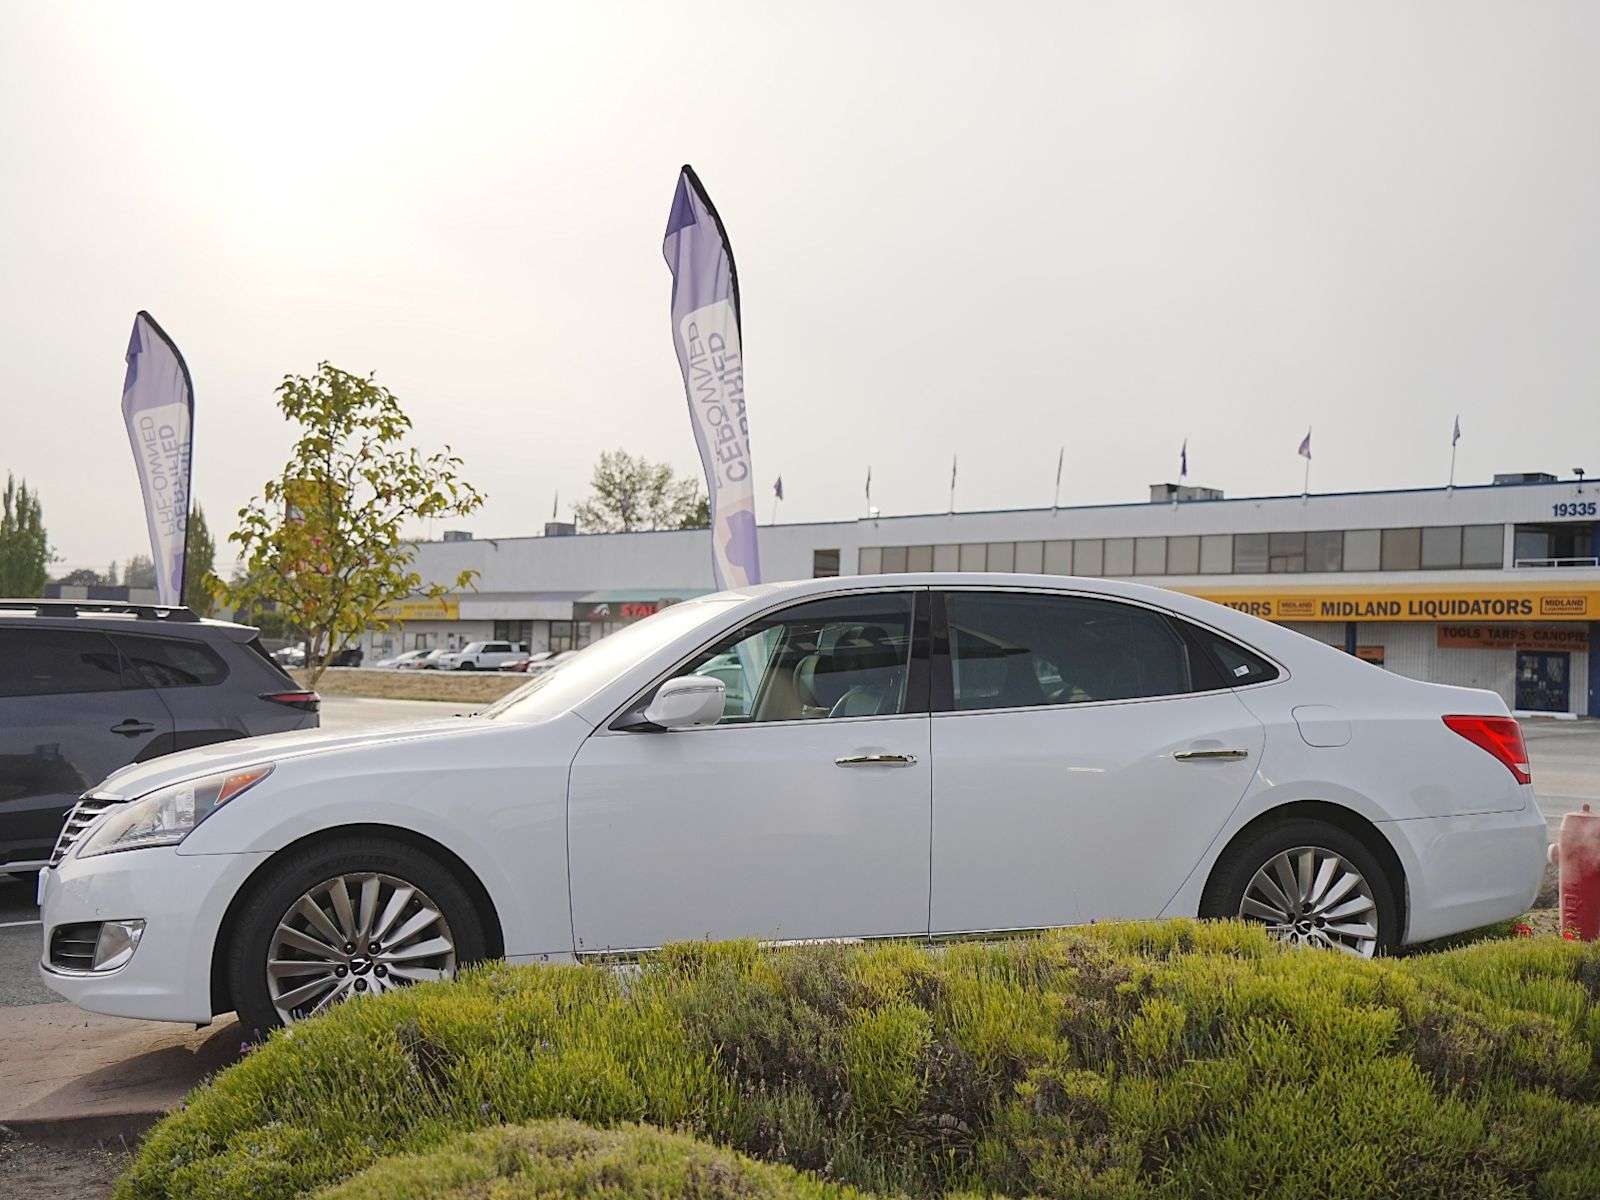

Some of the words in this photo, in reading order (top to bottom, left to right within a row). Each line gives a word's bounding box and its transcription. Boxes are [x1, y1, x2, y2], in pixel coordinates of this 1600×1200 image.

[1552, 502, 1596, 517] 19335
[1321, 601, 1401, 616] MIDLAND
[1408, 600, 1533, 618] LIQUIDATORS
[1545, 599, 1584, 607] MIDLAND
[1443, 627, 1480, 639] TOOLS
[1488, 628, 1525, 640] TARPS
[1533, 630, 1588, 642] CANOPIE
